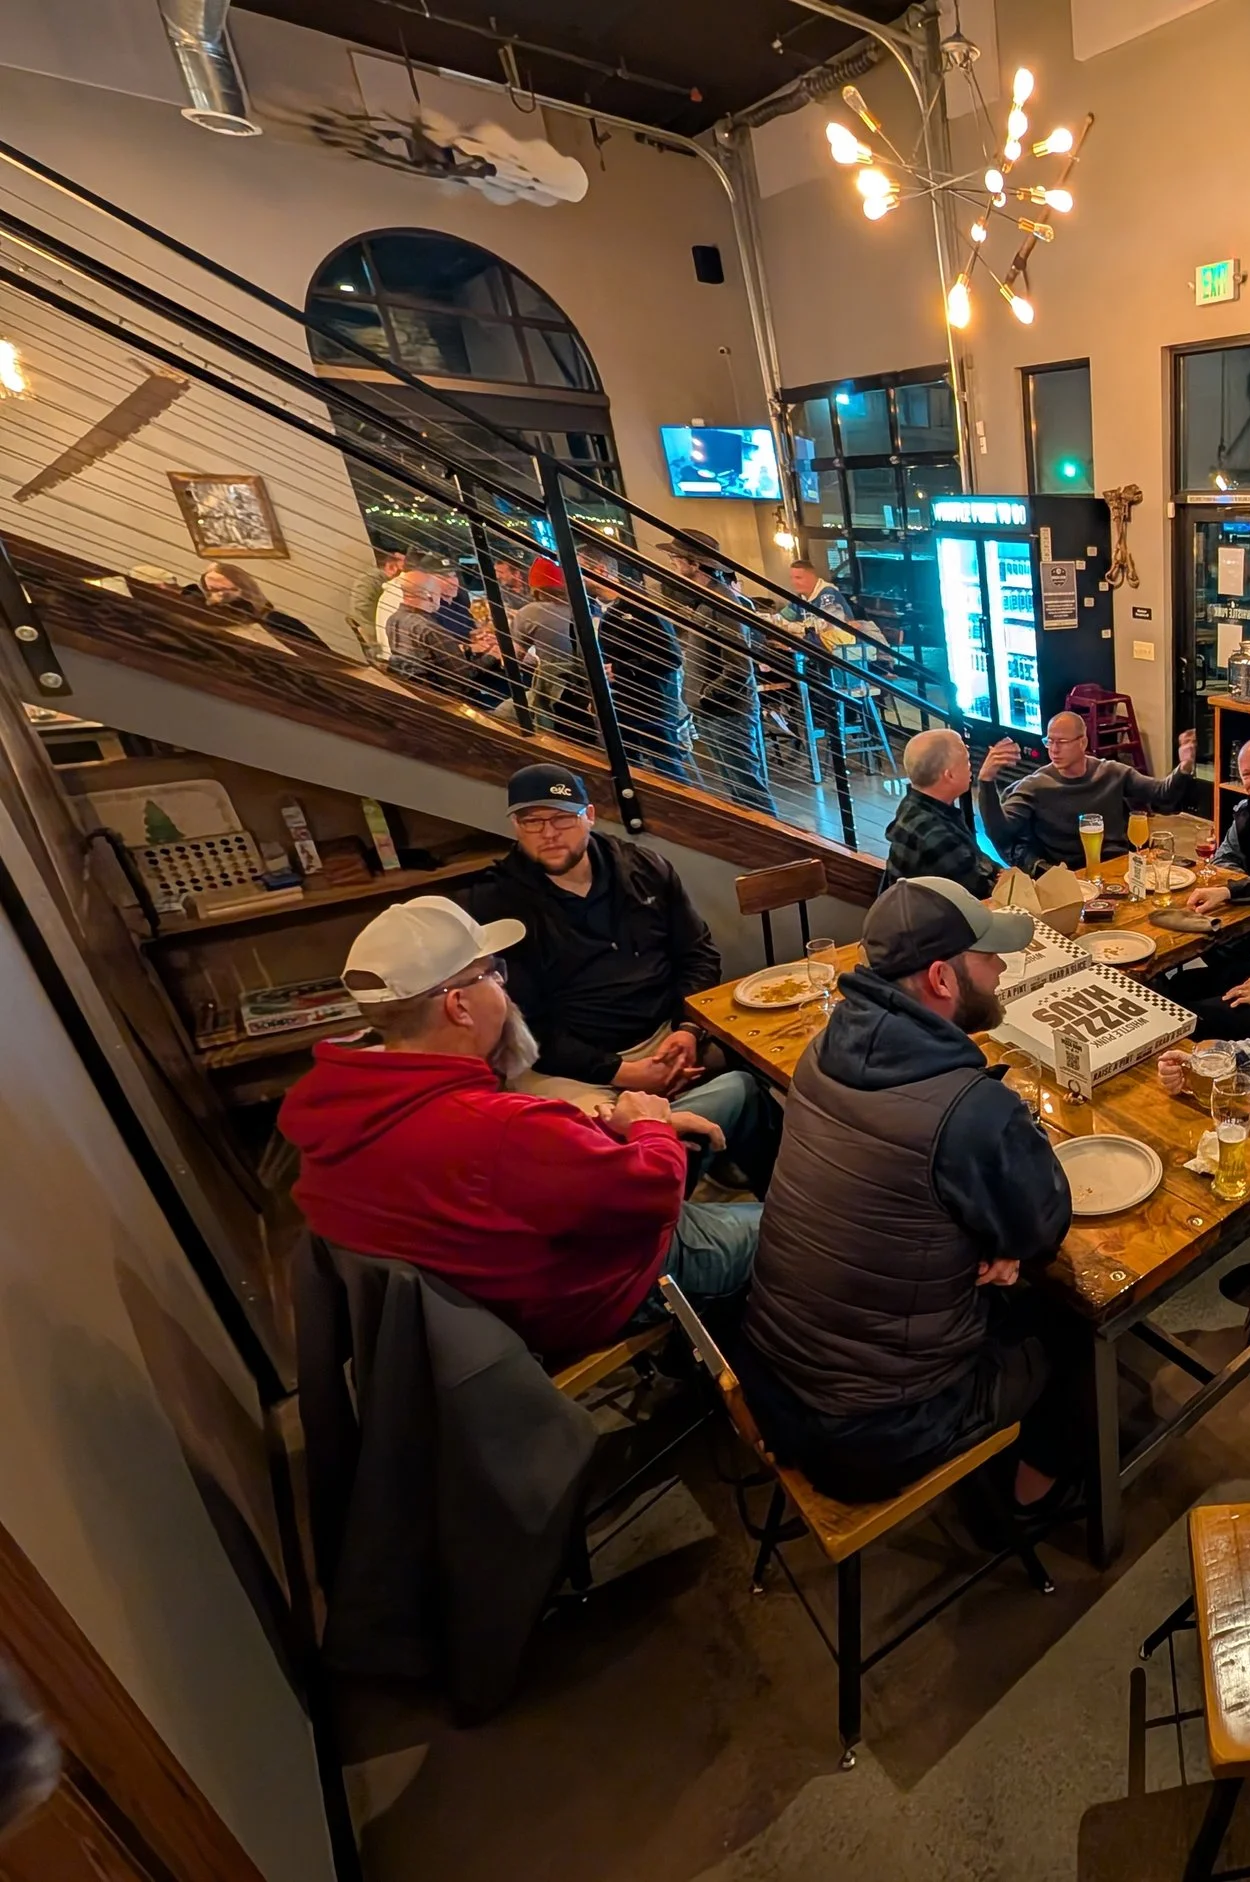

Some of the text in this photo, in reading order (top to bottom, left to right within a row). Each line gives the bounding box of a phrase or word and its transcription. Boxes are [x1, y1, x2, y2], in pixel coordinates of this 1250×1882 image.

[1202, 263, 1228, 299] EXIT
[1031, 984, 1118, 1028] HAUS
[1060, 997, 1149, 1043] PIZZA
[1090, 1017, 1150, 1048] WHISTLE PUNK
